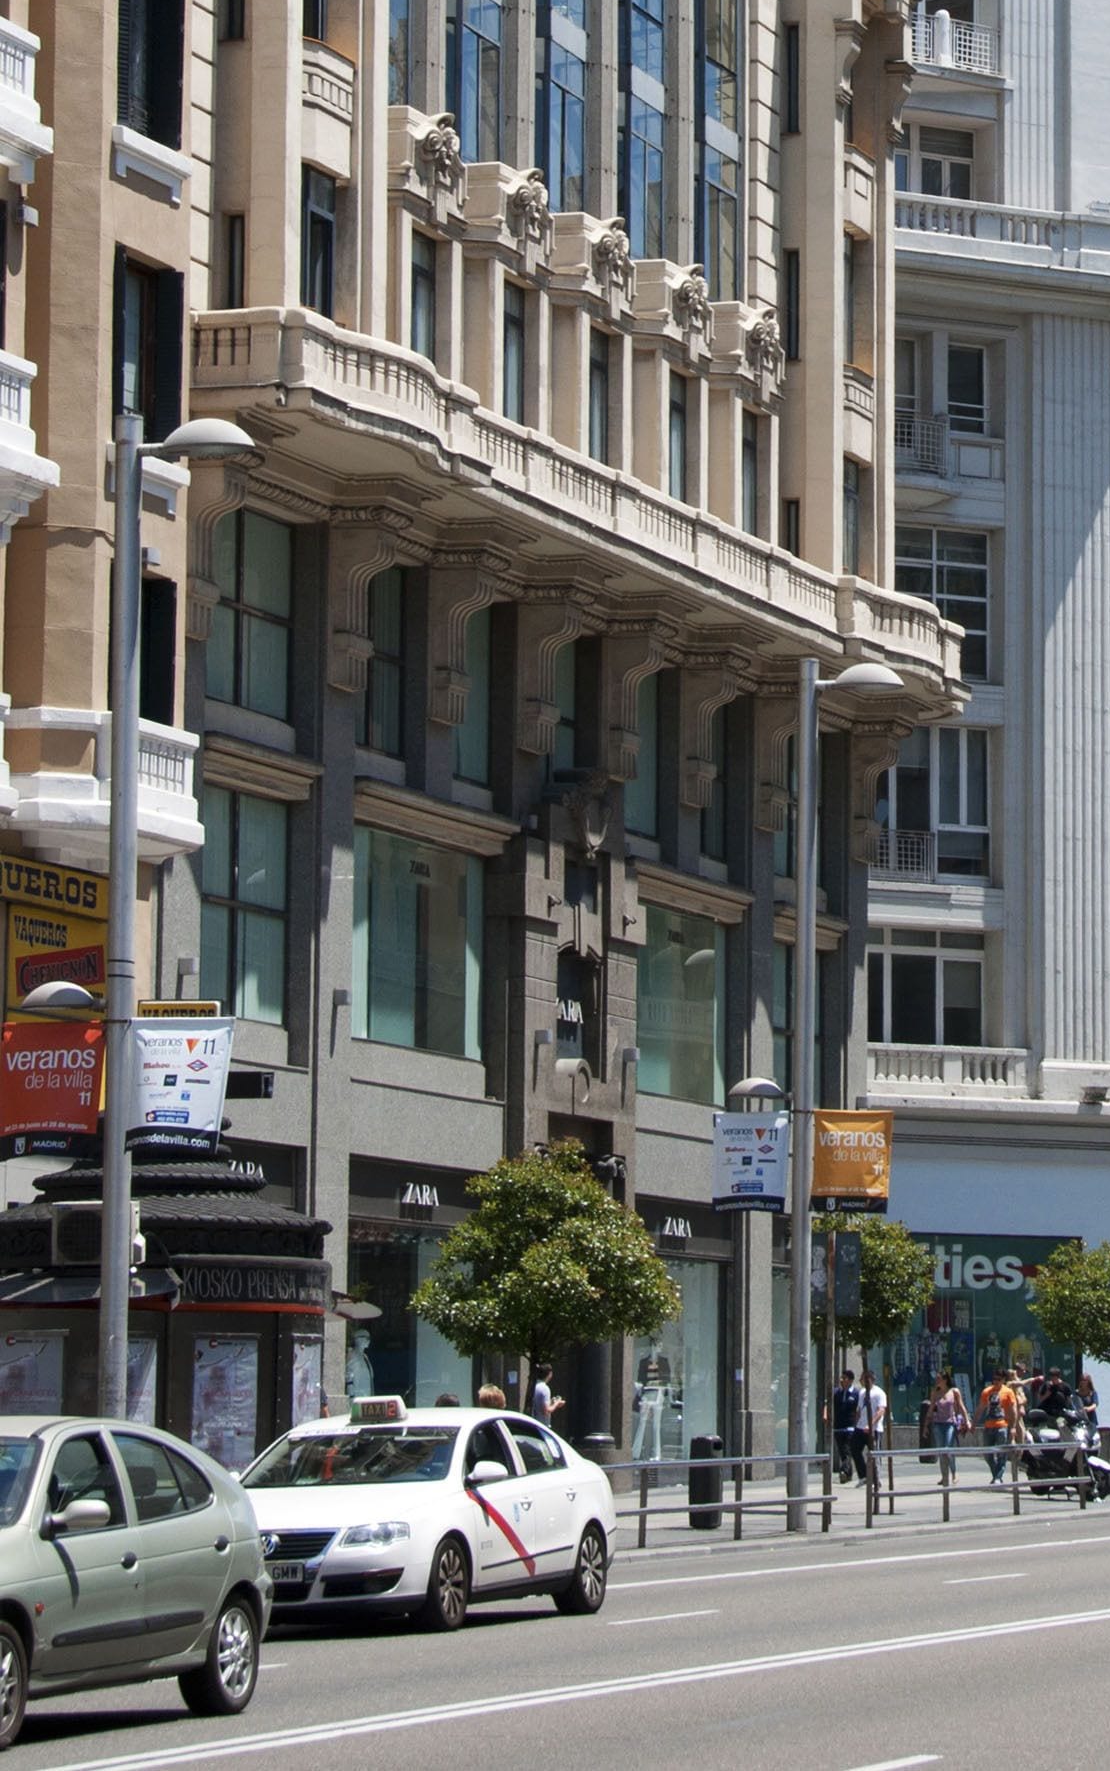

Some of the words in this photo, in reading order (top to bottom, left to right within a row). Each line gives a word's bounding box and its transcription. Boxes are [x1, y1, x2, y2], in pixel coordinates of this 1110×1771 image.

[0, 860, 97, 909] UEROS
[14, 915, 67, 947] VAQUEROS
[556, 997, 584, 1024] ARA
[143, 1038, 183, 1047] veranos
[203, 1038, 216, 1055] 11
[6, 1049, 95, 1071] veranos
[25, 1072, 44, 1089] de
[47, 1071, 60, 1088] la
[64, 1070, 92, 1088] villa
[79, 1091, 91, 1106] 11
[722, 1128, 753, 1136] veranos
[768, 1128, 778, 1141] 11
[820, 1131, 885, 1148] veranos
[32, 1140, 67, 1149] MADRID
[833, 1147, 847, 1161] de
[850, 1148, 860, 1161] la
[863, 1148, 884, 1162] villa
[872, 1164, 883, 1176] 11
[401, 1182, 440, 1207] ZARA
[662, 1216, 692, 1238] ZARA
[182, 1267, 242, 1298] KIOSKO
[249, 1268, 296, 1300] PRENSA
[363, 1403, 384, 1417] TAXI
[387, 1402, 396, 1417] 2
